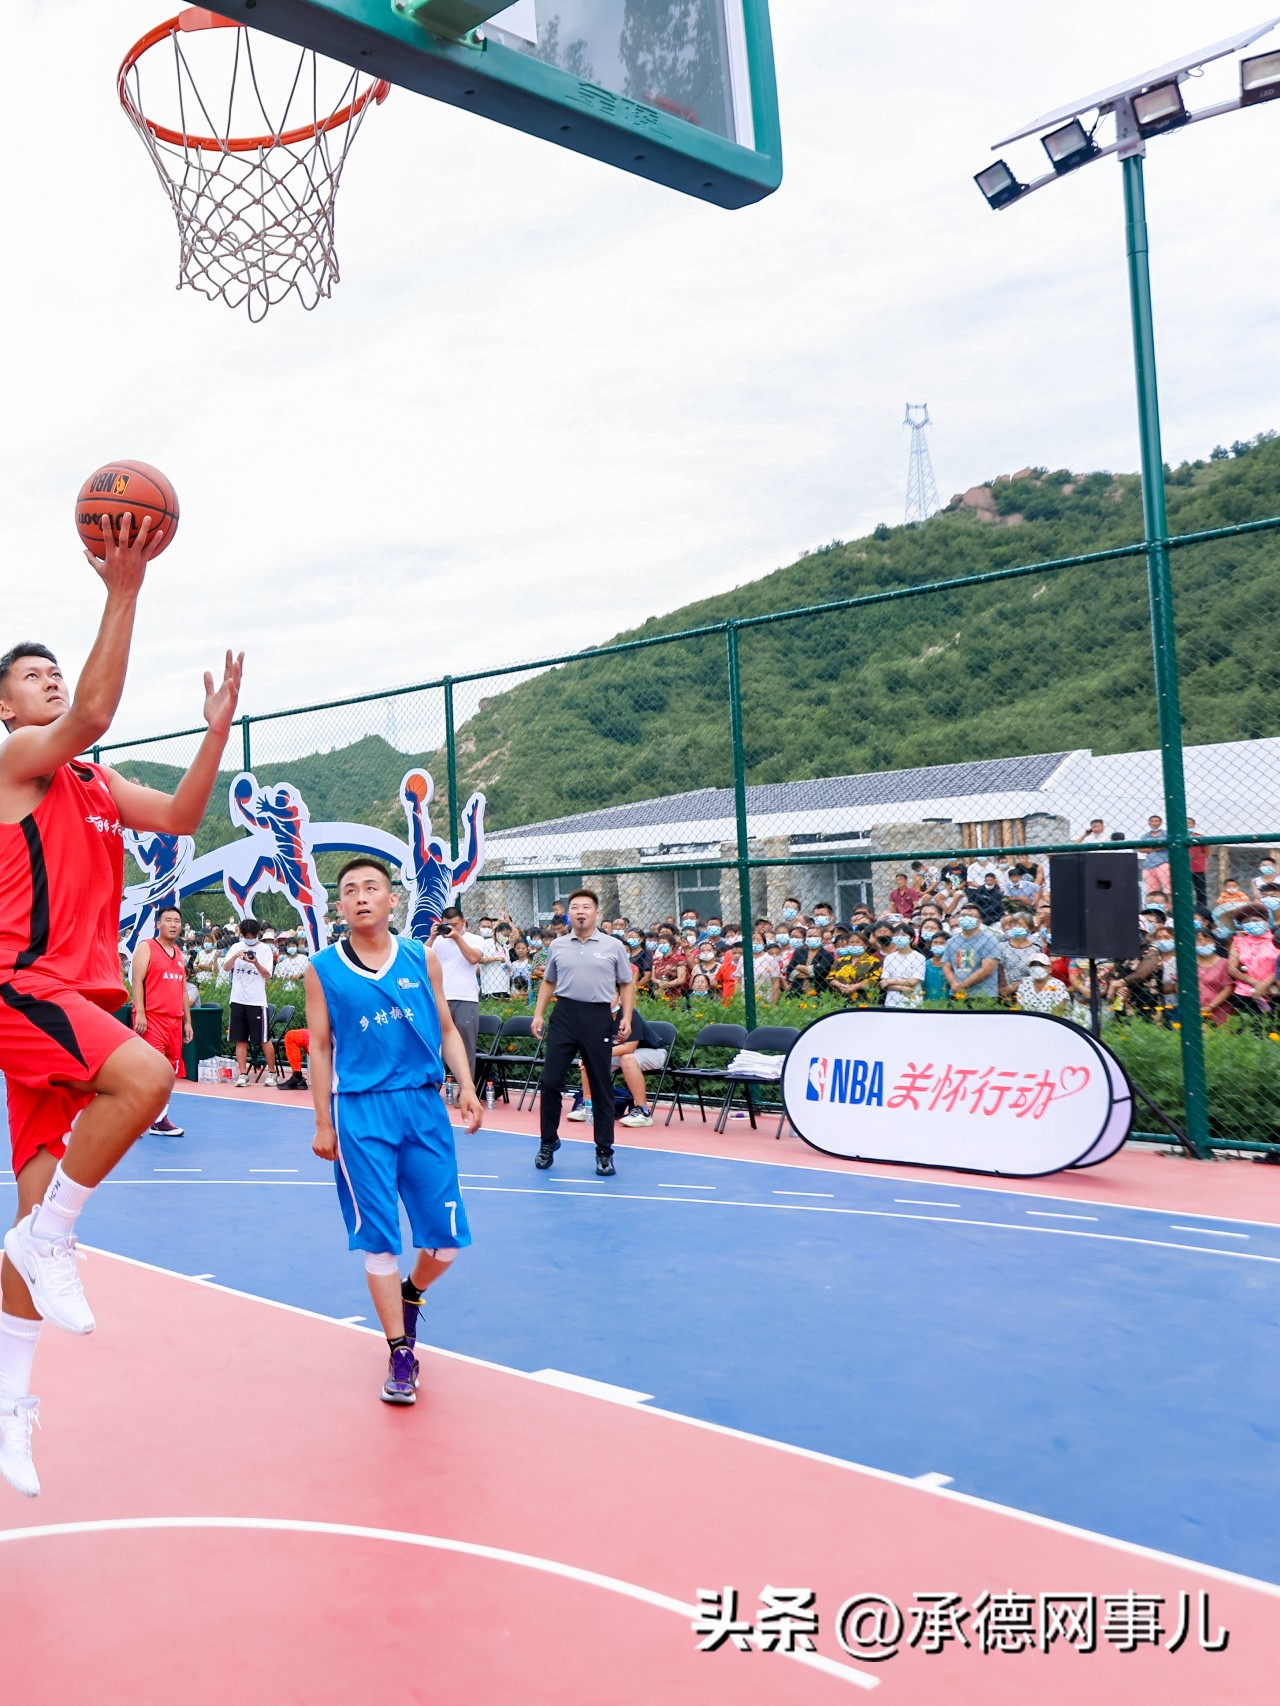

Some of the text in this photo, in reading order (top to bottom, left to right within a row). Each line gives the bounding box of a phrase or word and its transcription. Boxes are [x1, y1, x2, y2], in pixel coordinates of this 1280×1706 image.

[89, 472, 118, 493] NBA
[829, 1057, 1058, 1120] NBA 关怀行动
[444, 1200, 458, 1237] 7
